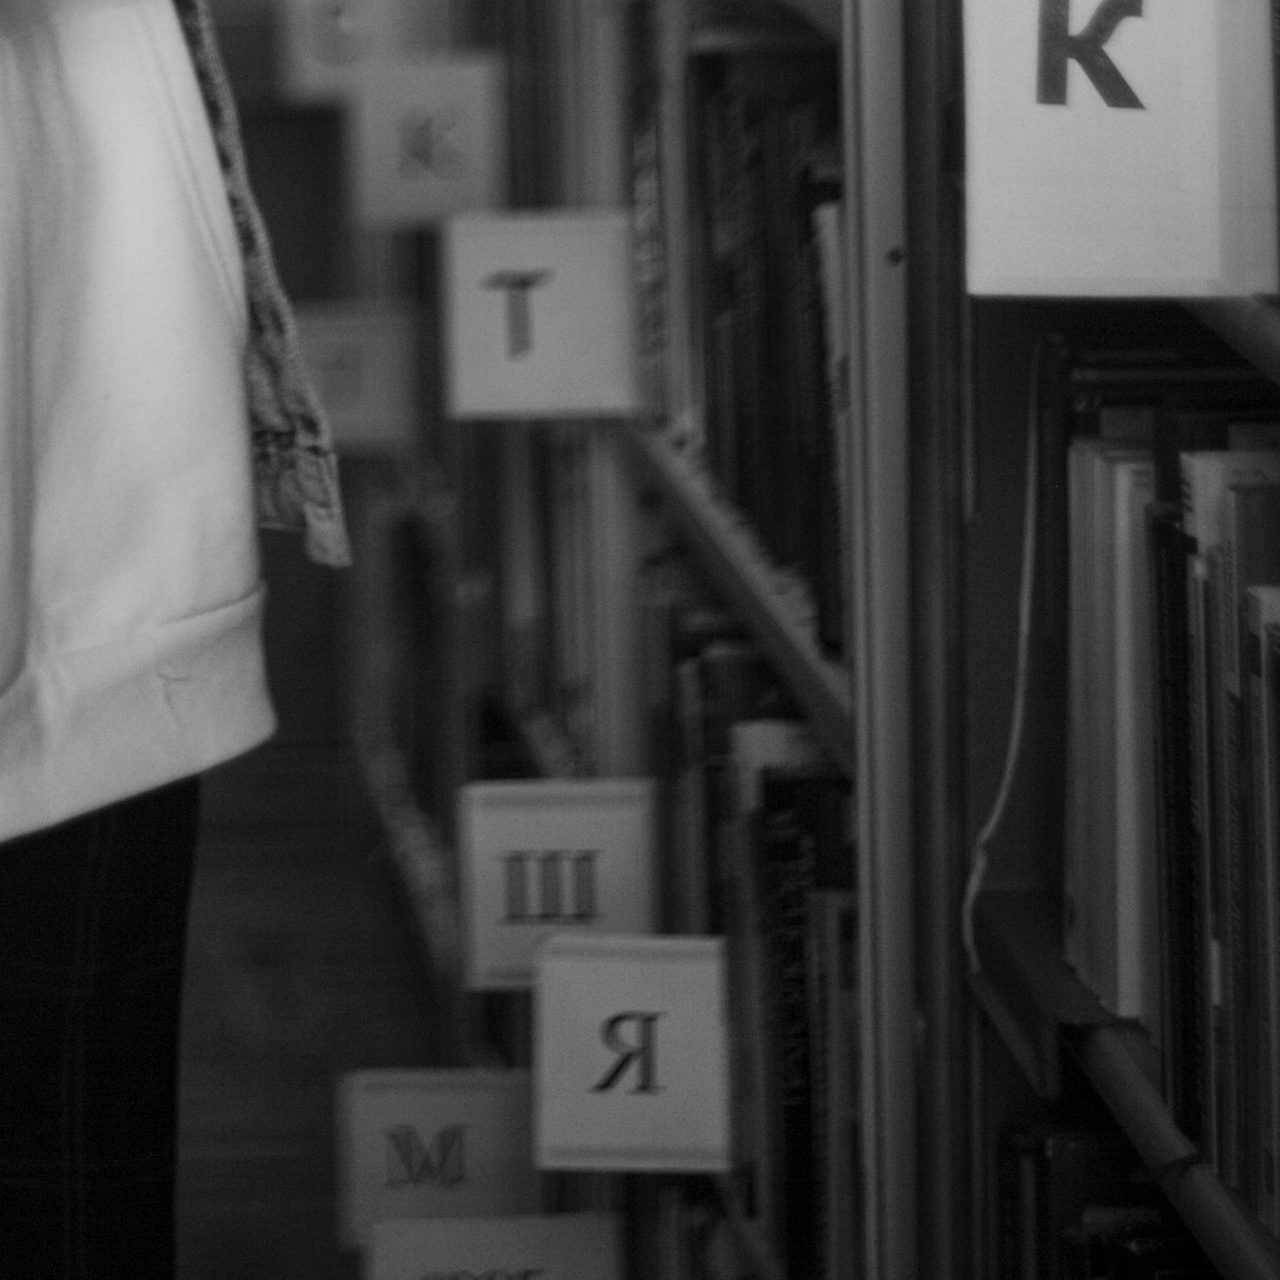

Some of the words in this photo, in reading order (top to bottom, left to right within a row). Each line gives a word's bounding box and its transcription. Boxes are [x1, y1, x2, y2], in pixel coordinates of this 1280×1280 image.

[477, 265, 558, 364] Т
[585, 1009, 670, 1097] Я
[383, 1121, 473, 1189] М
